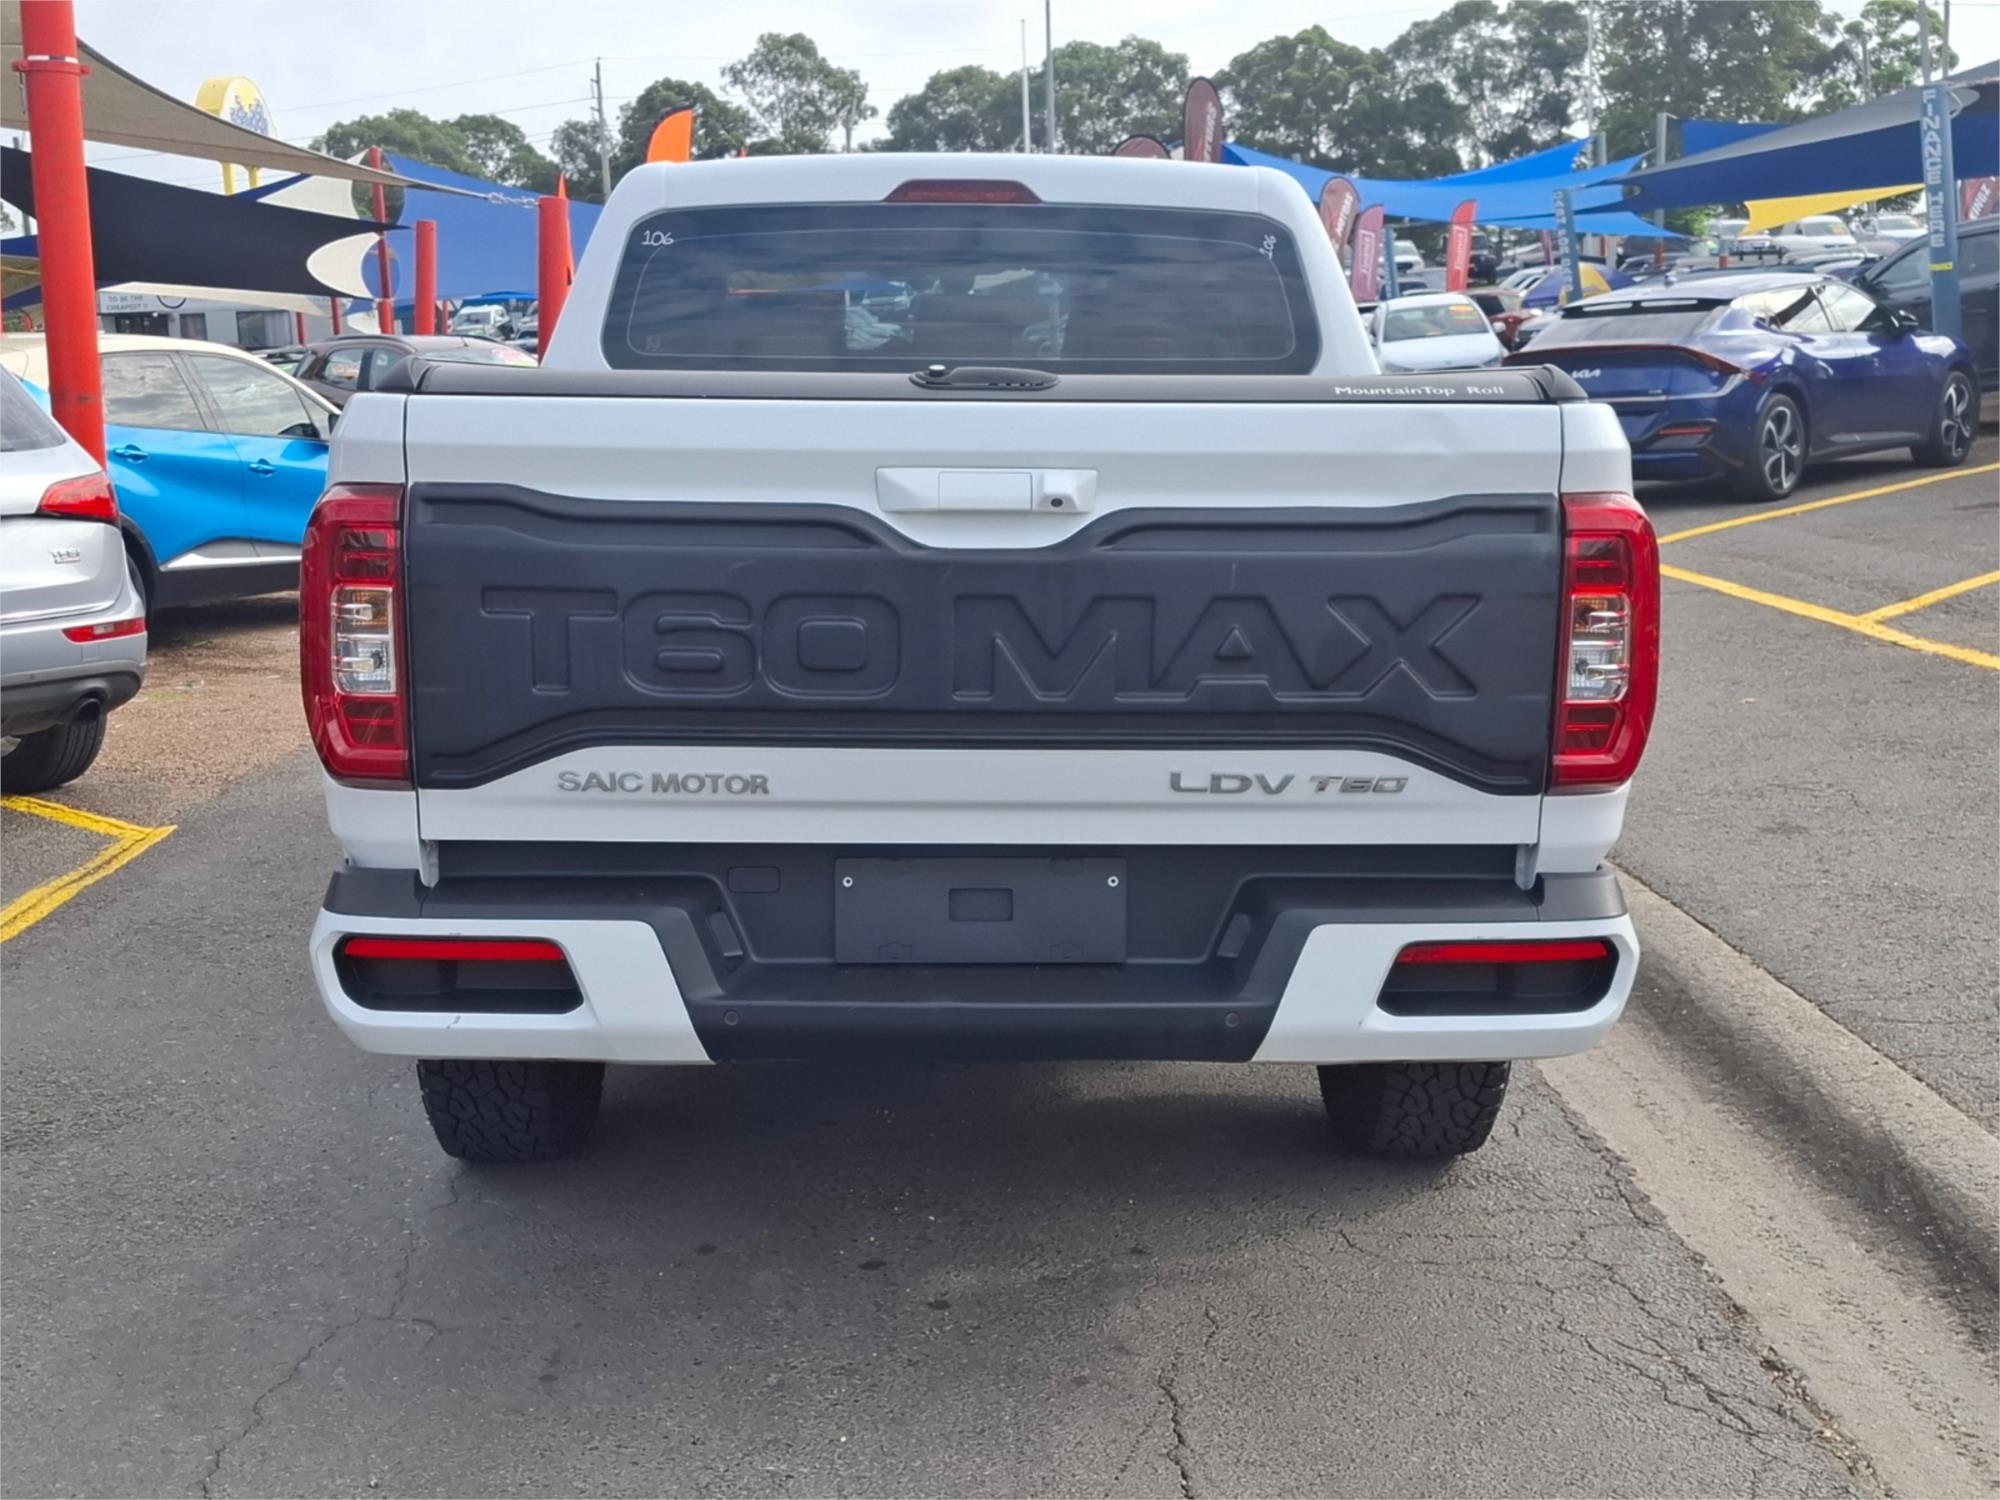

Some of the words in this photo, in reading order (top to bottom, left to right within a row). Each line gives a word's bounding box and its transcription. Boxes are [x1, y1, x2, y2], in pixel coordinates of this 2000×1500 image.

[1922, 89, 1943, 185] FINANCE
[1928, 191, 1945, 247] HERE
[641, 230, 675, 246] 106
[1260, 234, 1277, 260] 106
[1334, 386, 1456, 397] MountainTop
[1467, 386, 1504, 395] Roll
[482, 587, 901, 700] T60
[953, 593, 1482, 705] MAX
[557, 771, 643, 792] SAIC
[651, 773, 770, 794] MOTOR
[1170, 772, 1296, 795] LDV
[1309, 775, 1409, 793] T60
